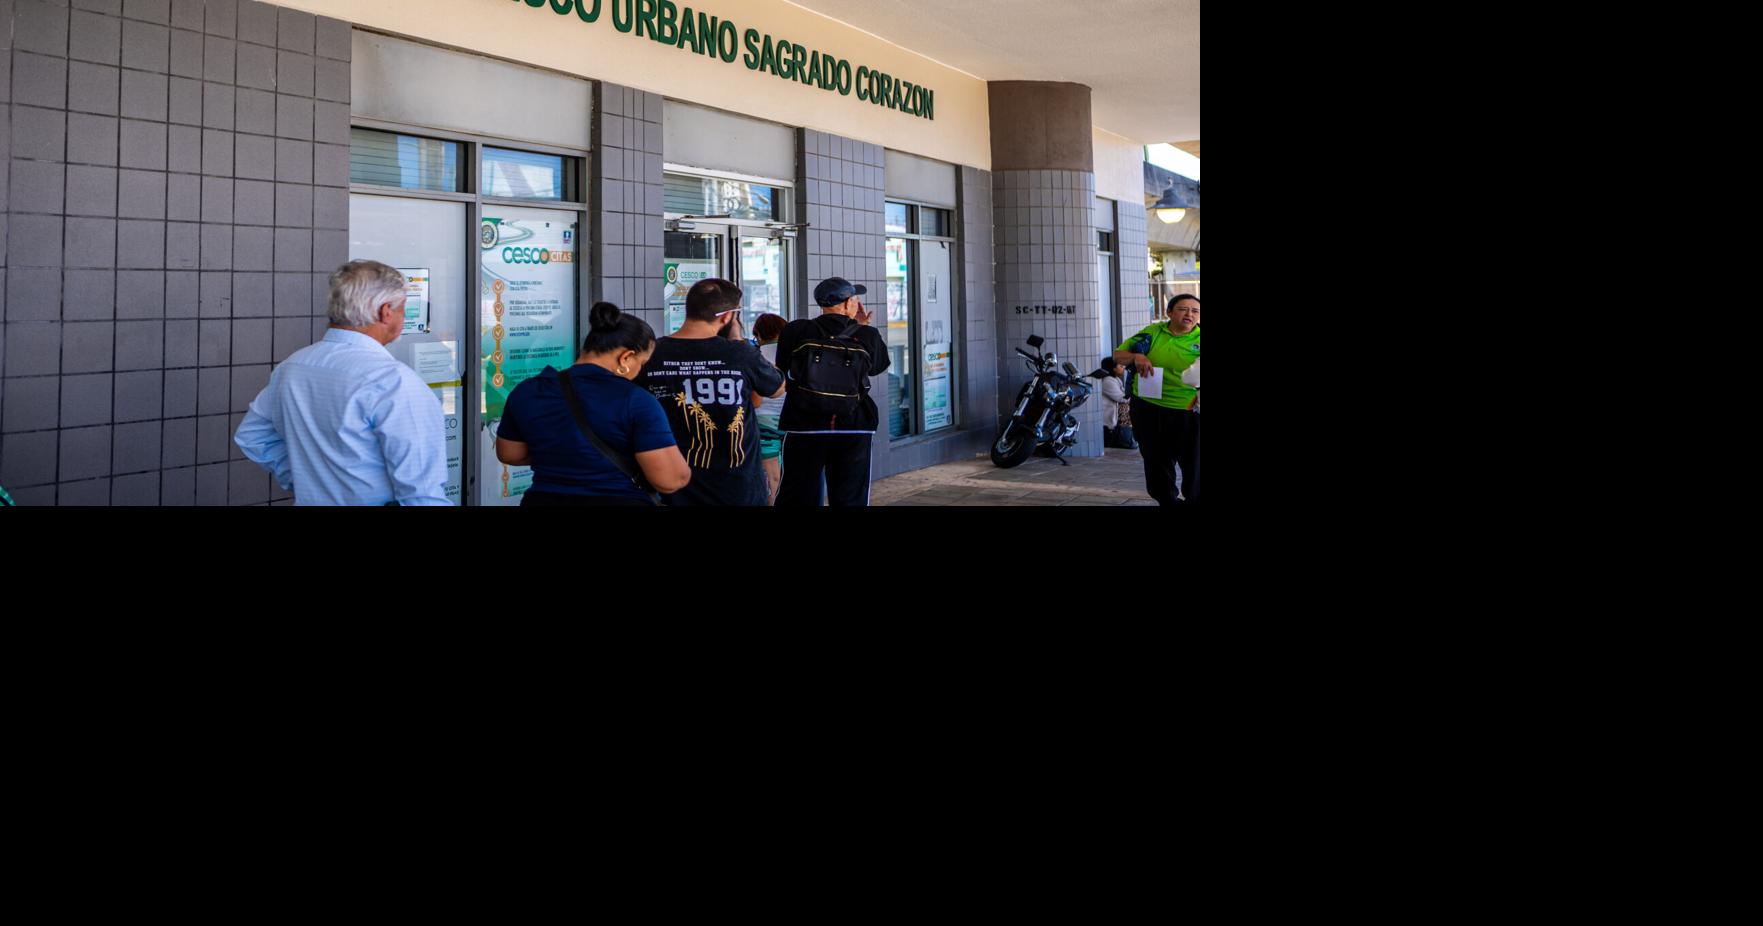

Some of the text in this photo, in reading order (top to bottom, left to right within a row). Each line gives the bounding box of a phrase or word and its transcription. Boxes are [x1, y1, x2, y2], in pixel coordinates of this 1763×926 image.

[611, 0, 935, 120] URBANO SAGRADO CORAZON
